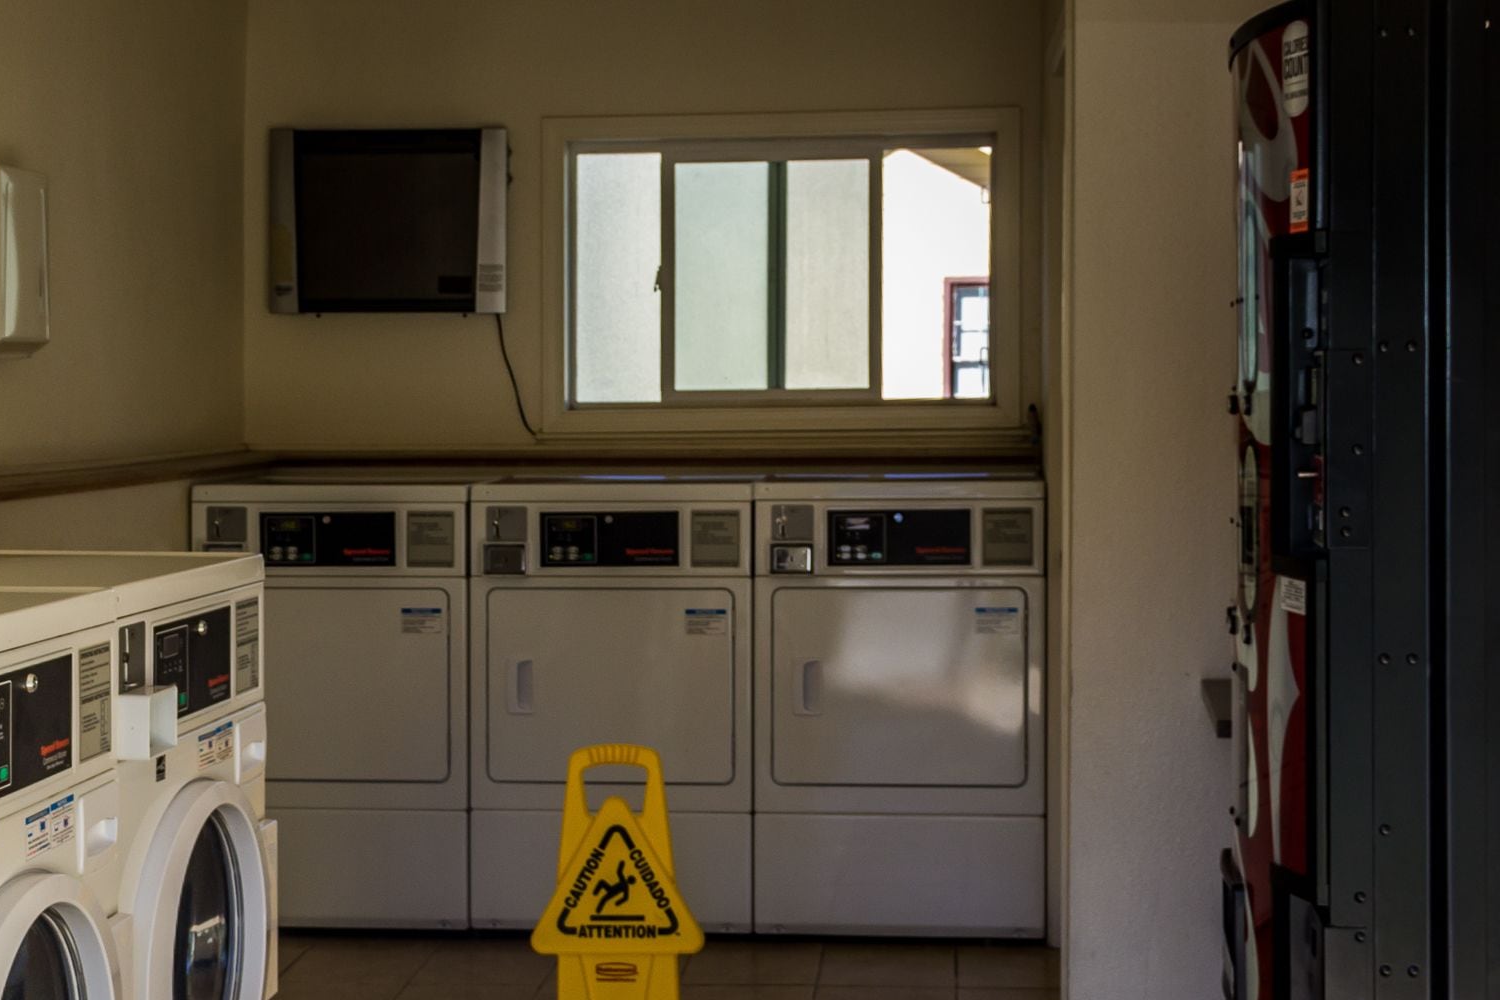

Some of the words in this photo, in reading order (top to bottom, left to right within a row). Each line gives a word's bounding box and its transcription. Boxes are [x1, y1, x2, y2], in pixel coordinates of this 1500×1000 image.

[565, 848, 605, 908] CAUTION
[630, 849, 670, 908] CUIDADO
[578, 925, 657, 938] ATTENTION
